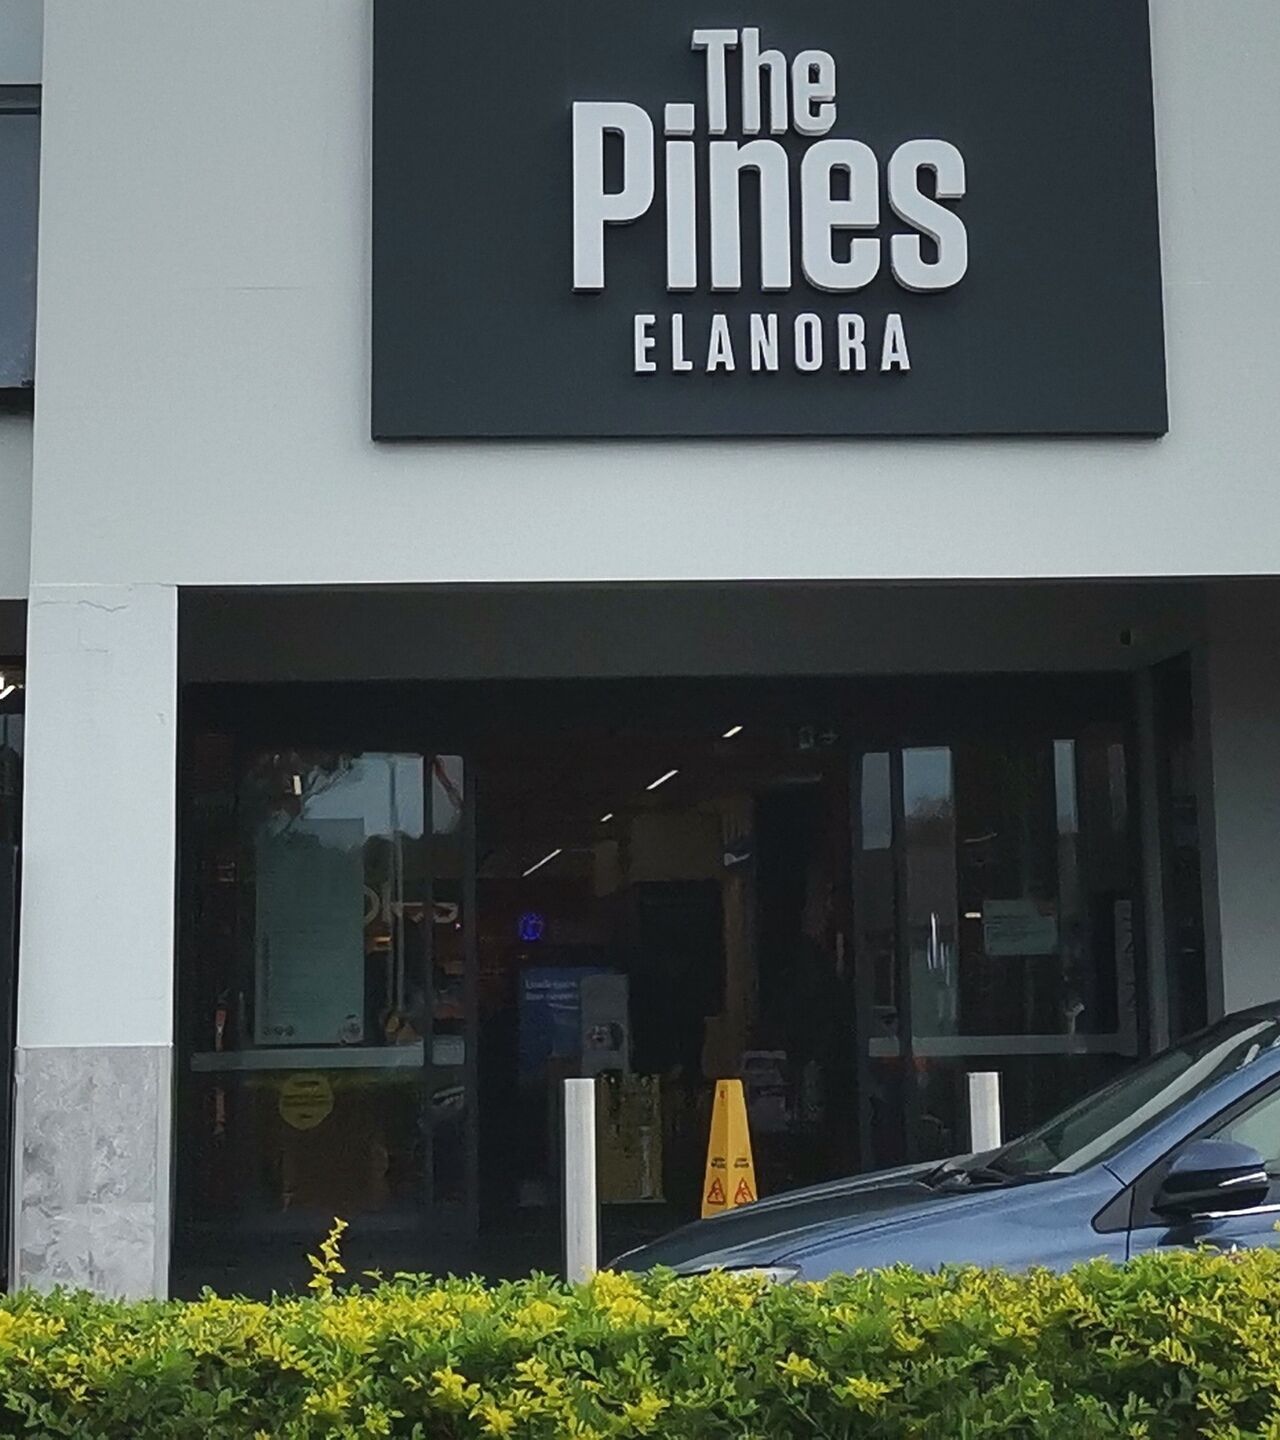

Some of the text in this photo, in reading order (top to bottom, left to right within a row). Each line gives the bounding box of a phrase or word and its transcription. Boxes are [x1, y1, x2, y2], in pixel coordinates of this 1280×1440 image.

[691, 27, 837, 136] The
[572, 101, 968, 293] Pines
[633, 312, 912, 373] ELANORA
